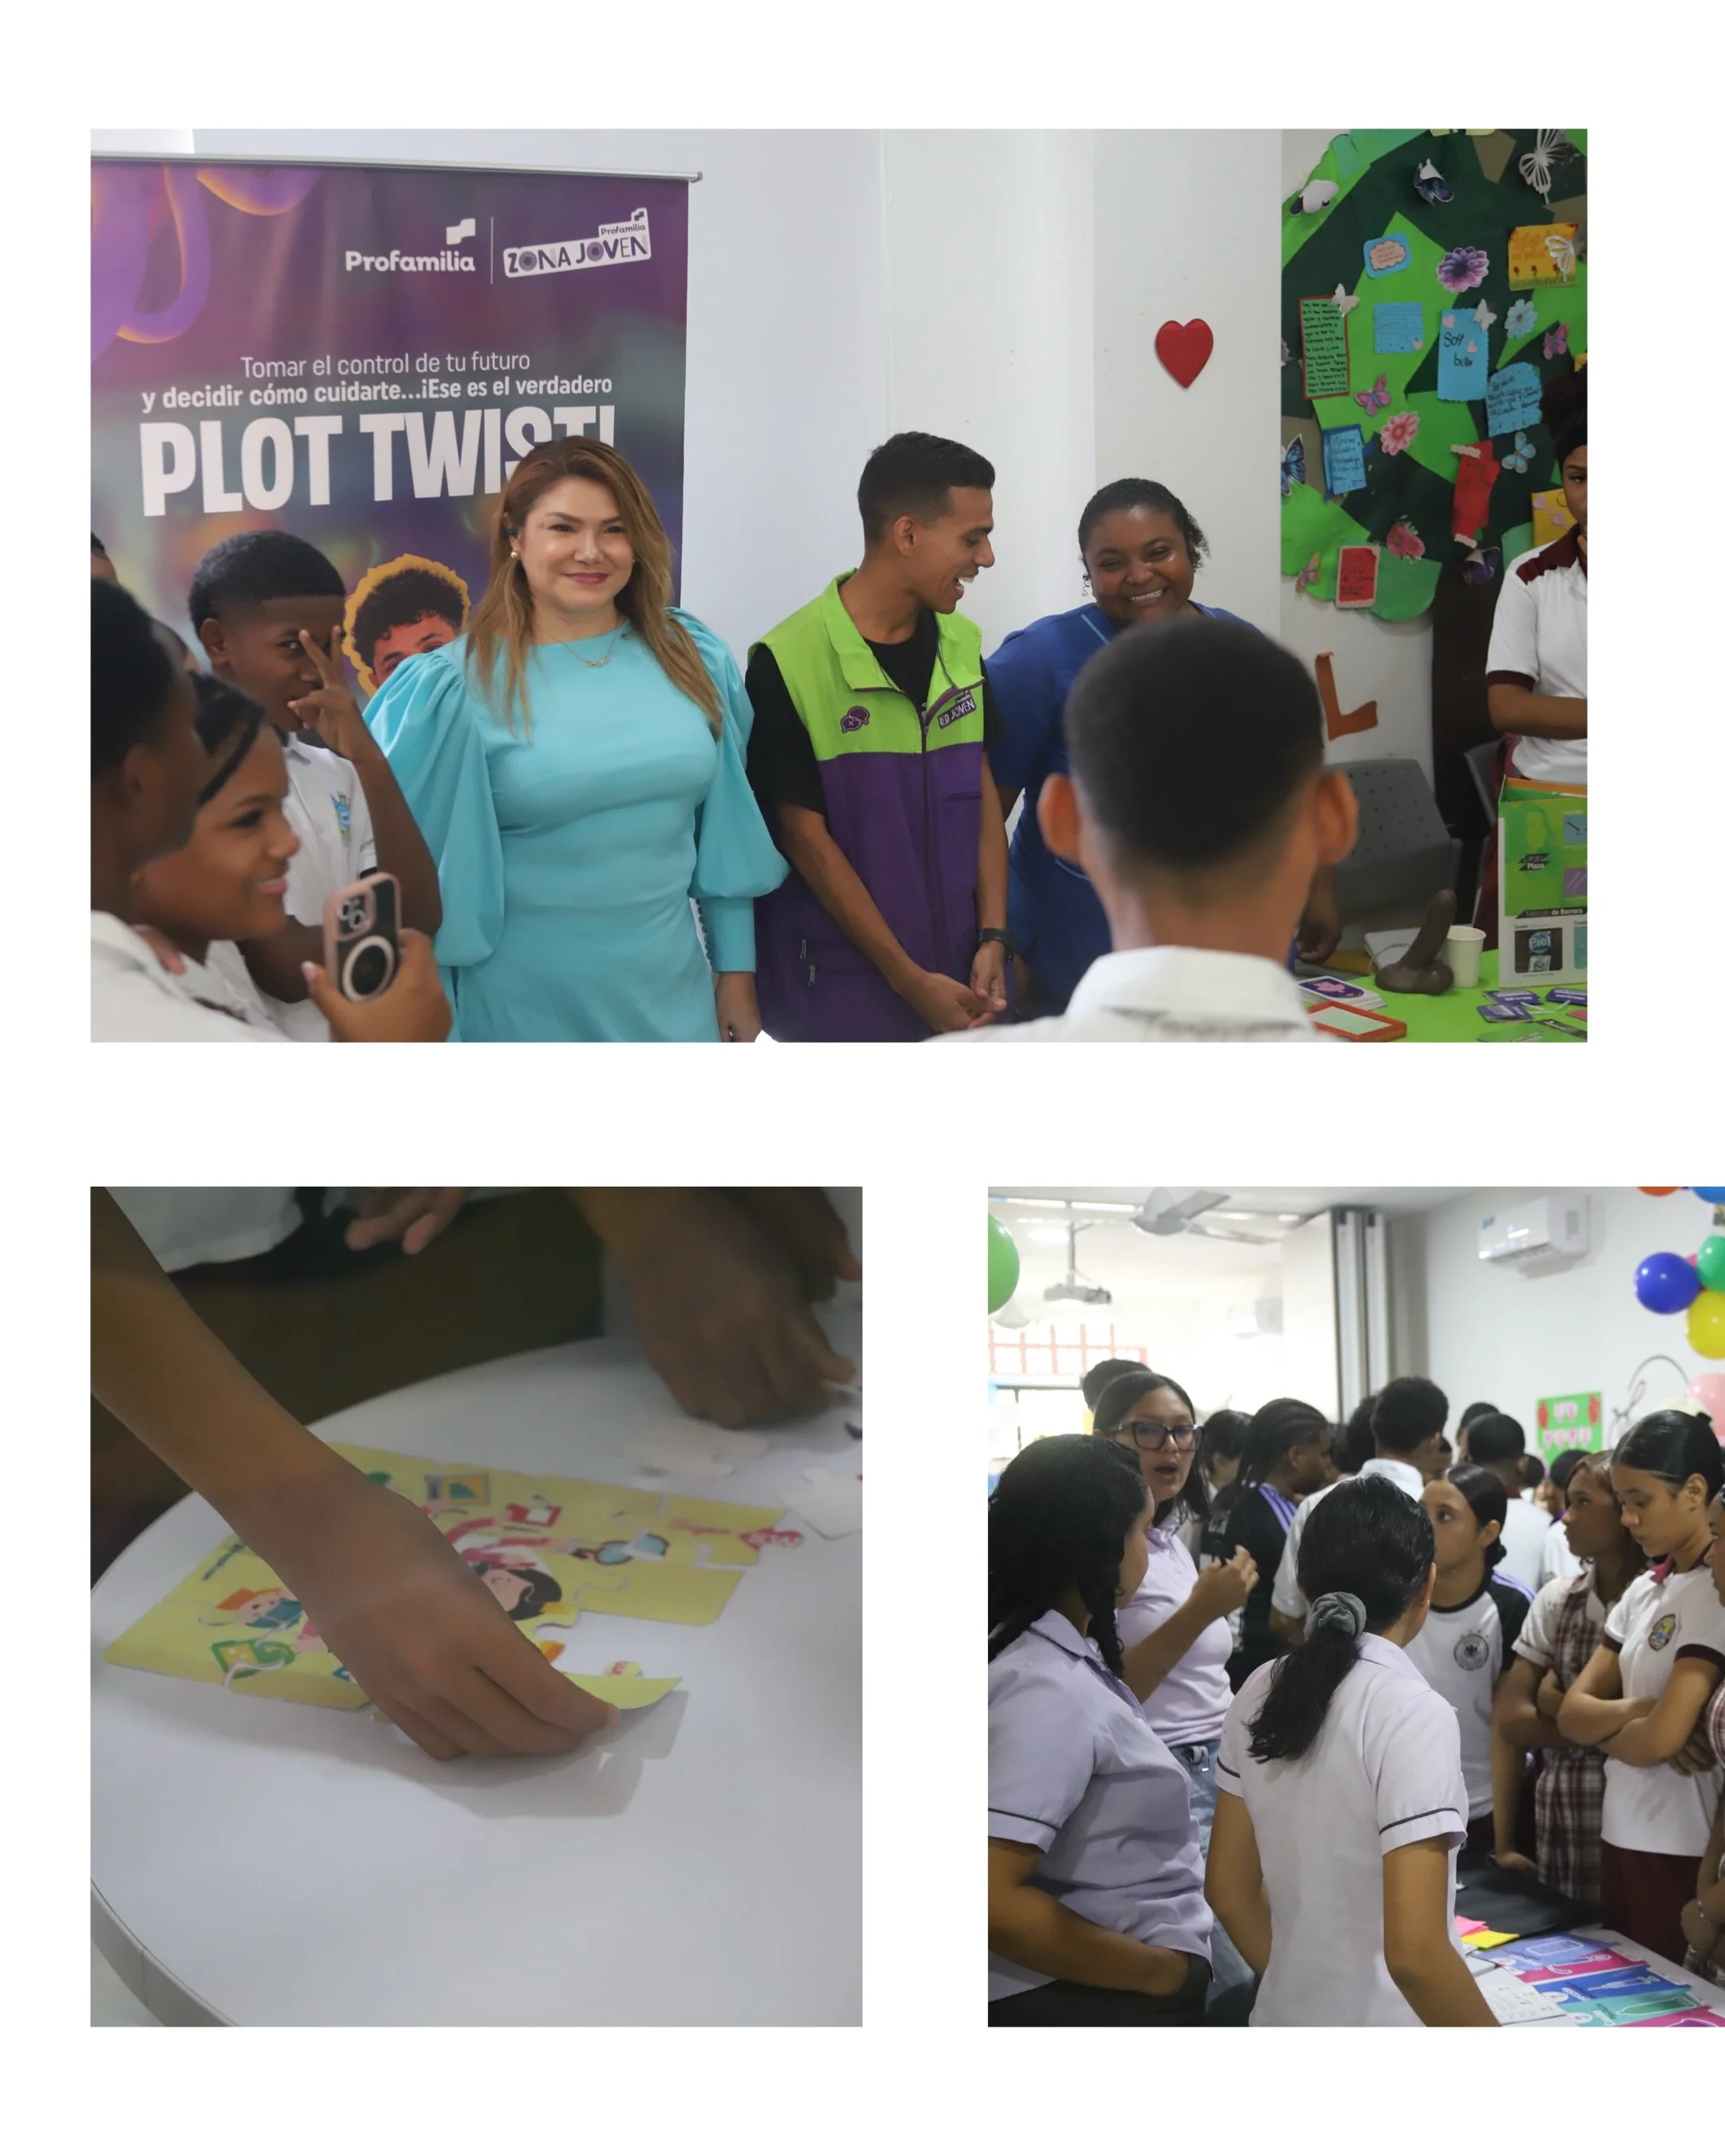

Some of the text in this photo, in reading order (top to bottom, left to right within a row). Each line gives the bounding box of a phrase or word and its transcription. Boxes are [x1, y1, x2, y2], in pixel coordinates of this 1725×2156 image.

[601, 224, 646, 235] Profamilia
[345, 249, 476, 271] Profamilia
[507, 235, 648, 273] ZONA JOVEN
[240, 351, 530, 378] Tomar el control de tu futuro
[141, 391, 156, 414] y
[162, 384, 243, 408] decidir
[249, 383, 307, 406] cómo
[467, 379, 488, 398] es
[493, 376, 510, 395] el
[515, 375, 613, 394] verdadero
[140, 416, 343, 517] PLOT
[950, 699, 976, 720] JOVEN
